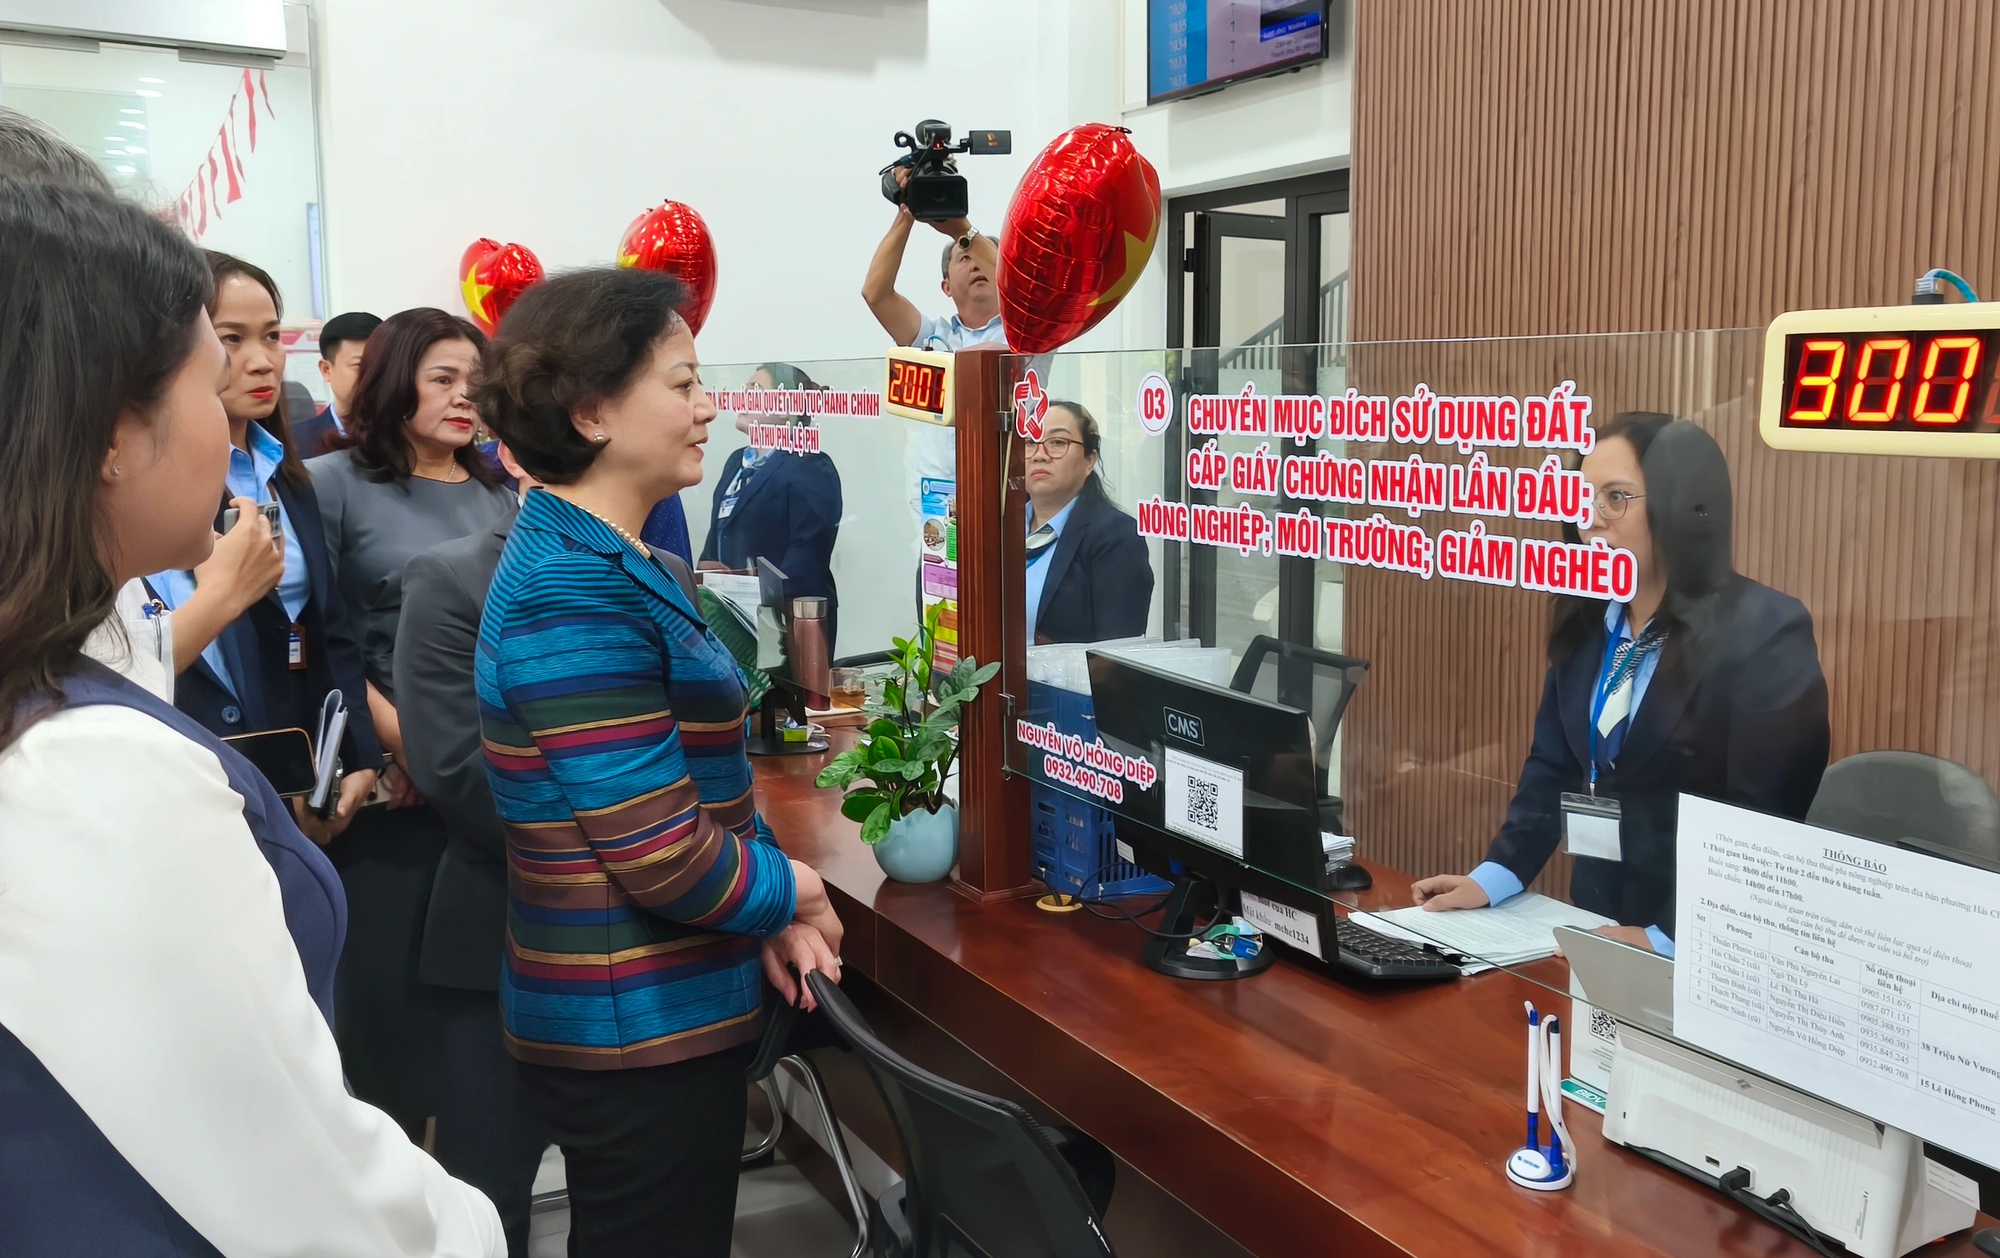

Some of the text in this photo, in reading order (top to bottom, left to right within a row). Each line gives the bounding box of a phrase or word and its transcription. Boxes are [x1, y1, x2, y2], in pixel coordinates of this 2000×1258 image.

[718, 386, 730, 411] KẾT
[732, 385, 746, 413] QUẢ
[747, 385, 761, 412] GIẢI
[763, 385, 787, 414] QUYẾT
[788, 385, 804, 413] THỦ
[805, 392, 822, 417] TỤC
[824, 387, 848, 415] HÀNH
[851, 389, 880, 416] CHÍNH
[1143, 388, 1165, 420] 03
[1190, 385, 1591, 448] CHUYỂN MỤC ĐÍCH SỬ DỤNG ĐẤT,
[749, 423, 819, 452] VÀ THU PHÍ, LỆ PHÍ
[1189, 446, 1590, 523] CẤP GIẤY CHỨNG NHẬN LẦN ĐẦU;
[1138, 498, 1633, 597] NÔNG NGHIỆP; MÔI TRƯỜNG; GIẢM NGHÈO
[1168, 713, 1199, 739] CMS
[1018, 723, 1062, 752] NGUYỄN
[1065, 736, 1082, 758] VÕ
[1085, 740, 1123, 773] HỒNG
[1126, 758, 1155, 786] DIỆP
[1046, 757, 1121, 800] 0932.490.708
[1709, 843, 1724, 854] Thời
[1726, 849, 1740, 859] gian
[1742, 852, 1755, 863] làm
[1756, 857, 1772, 868] việc:
[1774, 861, 1784, 871] Từ
[1786, 866, 1798, 875] thứ
[1800, 869, 1805, 877] 2
[1806, 870, 1819, 881] đến
[1821, 876, 1834, 885] thứ
[1842, 881, 1861, 895] hàng
[1863, 887, 1883, 900] tuần.
[1823, 848, 1887, 872] THÔNG BÁO
[1742, 865, 1798, 888] 8h00 đến 11h00.
[1806, 858, 1817, 868] thu
[1868, 877, 1893, 890] nghiệp
[1894, 883, 1909, 894] trên
[1911, 887, 1923, 897] địa
[1925, 890, 1938, 902] bàn
[1940, 896, 1971, 912] phường
[1973, 904, 1987, 916] Hải
[1745, 879, 1804, 903] 14h00 đến 17h00.
[1274, 922, 1310, 945] mchc1234
[1700, 897, 1706, 905] 2.
[1707, 899, 1718, 909] Địa
[1739, 911, 1751, 920] cán
[1753, 913, 1762, 924] bộ
[1763, 918, 1777, 928] thu,
[1778, 922, 1799, 936] thông
[1800, 929, 1810, 938] tin
[1812, 932, 1825, 943] liên
[1827, 937, 1836, 948] hệ
[1726, 923, 1753, 939] Phường
[1794, 945, 1834, 965] Cán bộ thu
[1853, 926, 1863, 934] có
[1892, 937, 1904, 947] lạc
[1905, 943, 1920, 952] qua
[1932, 950, 1950, 961] điện
[1951, 956, 1972, 968] thoại
[1865, 961, 1916, 987] Số điện thoại
[1877, 978, 1903, 995] liên hệ
[1861, 986, 1911, 1010] 0905.151.676
[1931, 991, 1999, 1021] Địa chỉ nộp thuế
[1860, 1000, 1910, 1024] 0987.071.131
[1829, 1029, 1844, 1041] Anh
[1860, 1013, 1910, 1037] 0905.388.937
[1860, 1026, 1910, 1051] 0935.360.303
[1859, 1040, 1909, 1064] 0935.845.245
[1921, 1042, 1930, 1051] 38
[1932, 1046, 1955, 1061] Triệu
[1958, 1055, 1970, 1066] Nữ
[1859, 1055, 1909, 1080] 0932.490.708
[1575, 1088, 1607, 1103] BIDV
[1920, 1078, 1996, 1115] 15 Lê Hồng Phong
